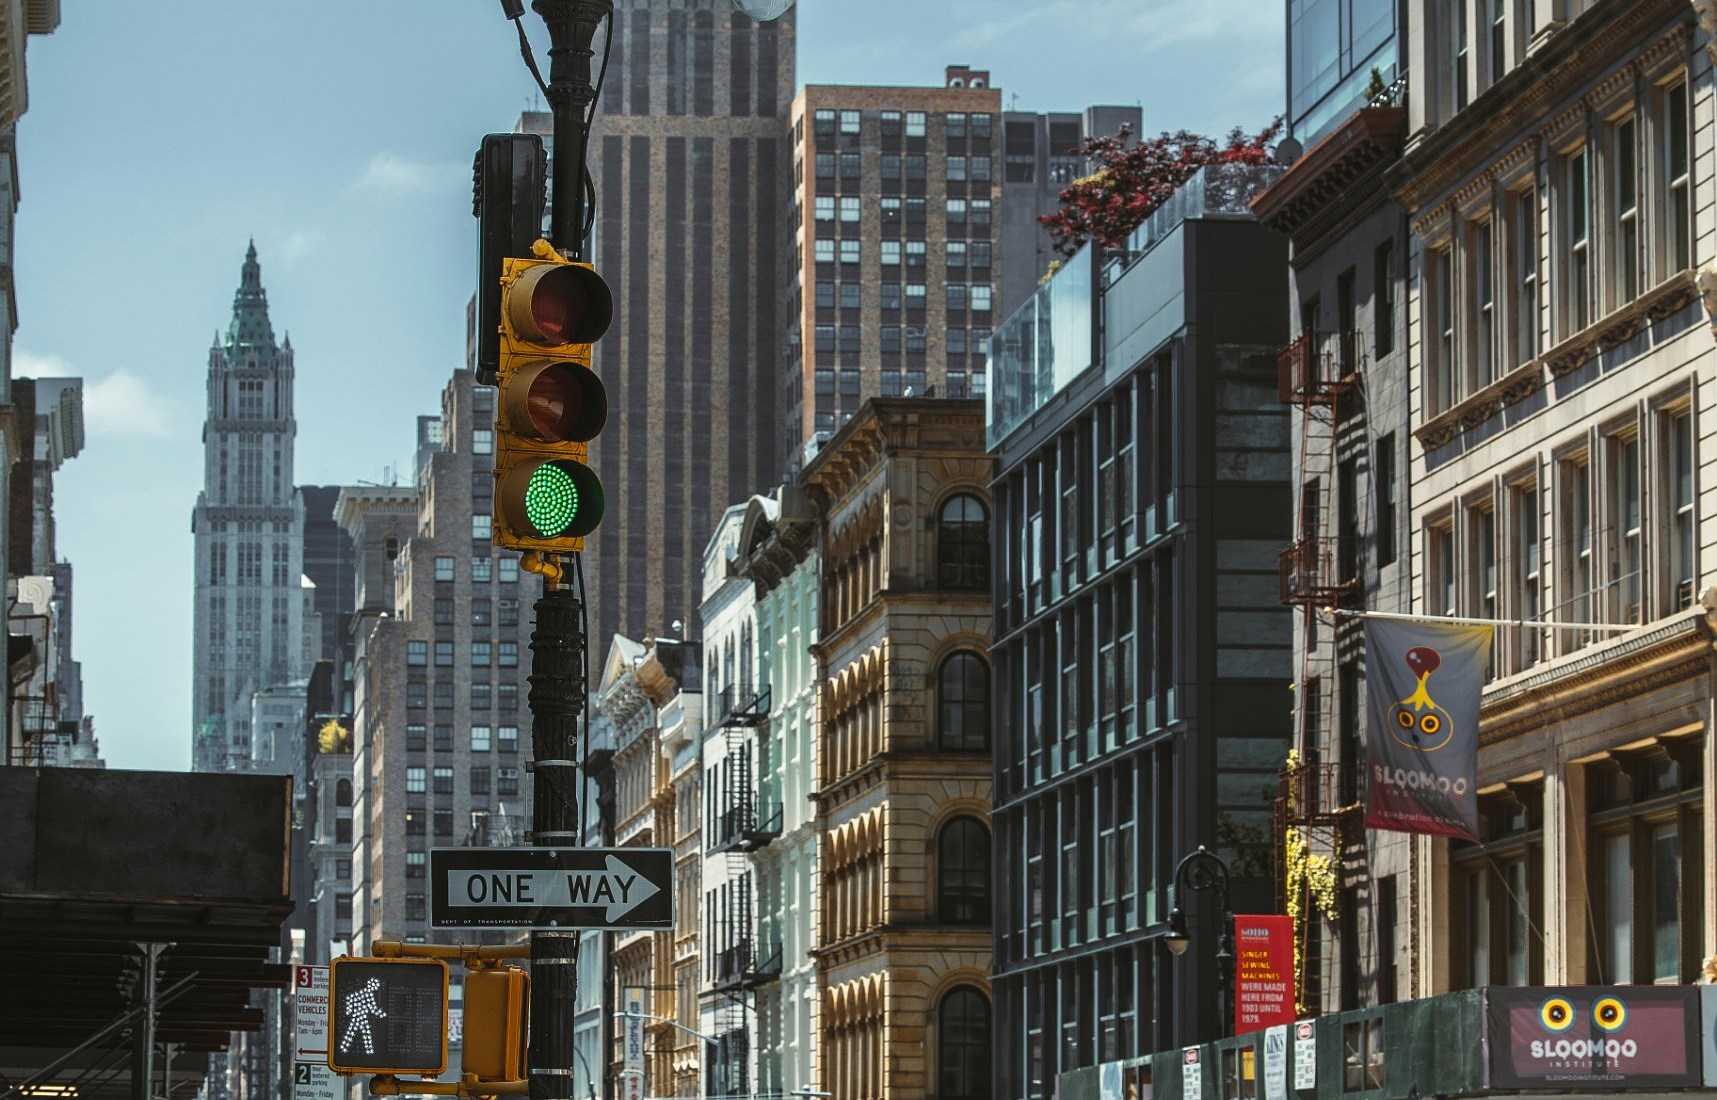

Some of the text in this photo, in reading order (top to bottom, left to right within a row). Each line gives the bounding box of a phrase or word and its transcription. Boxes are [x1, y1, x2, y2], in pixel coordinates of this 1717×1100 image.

[1374, 765, 1467, 795] SLOOMOO
[467, 874, 636, 903] ONE WAY
[300, 968, 309, 986] 3
[1241, 982, 1286, 991] WERE MADE
[1241, 993, 1284, 1002] HERE FROM
[298, 1005, 327, 1015] VEHICLES
[1260, 1004, 1281, 1013] UNTIL
[1530, 1038, 1637, 1060] SLOOMOO
[299, 1065, 307, 1083] 2
[297, 1090, 314, 1098] Monday
[319, 1090, 334, 1098] Friday
